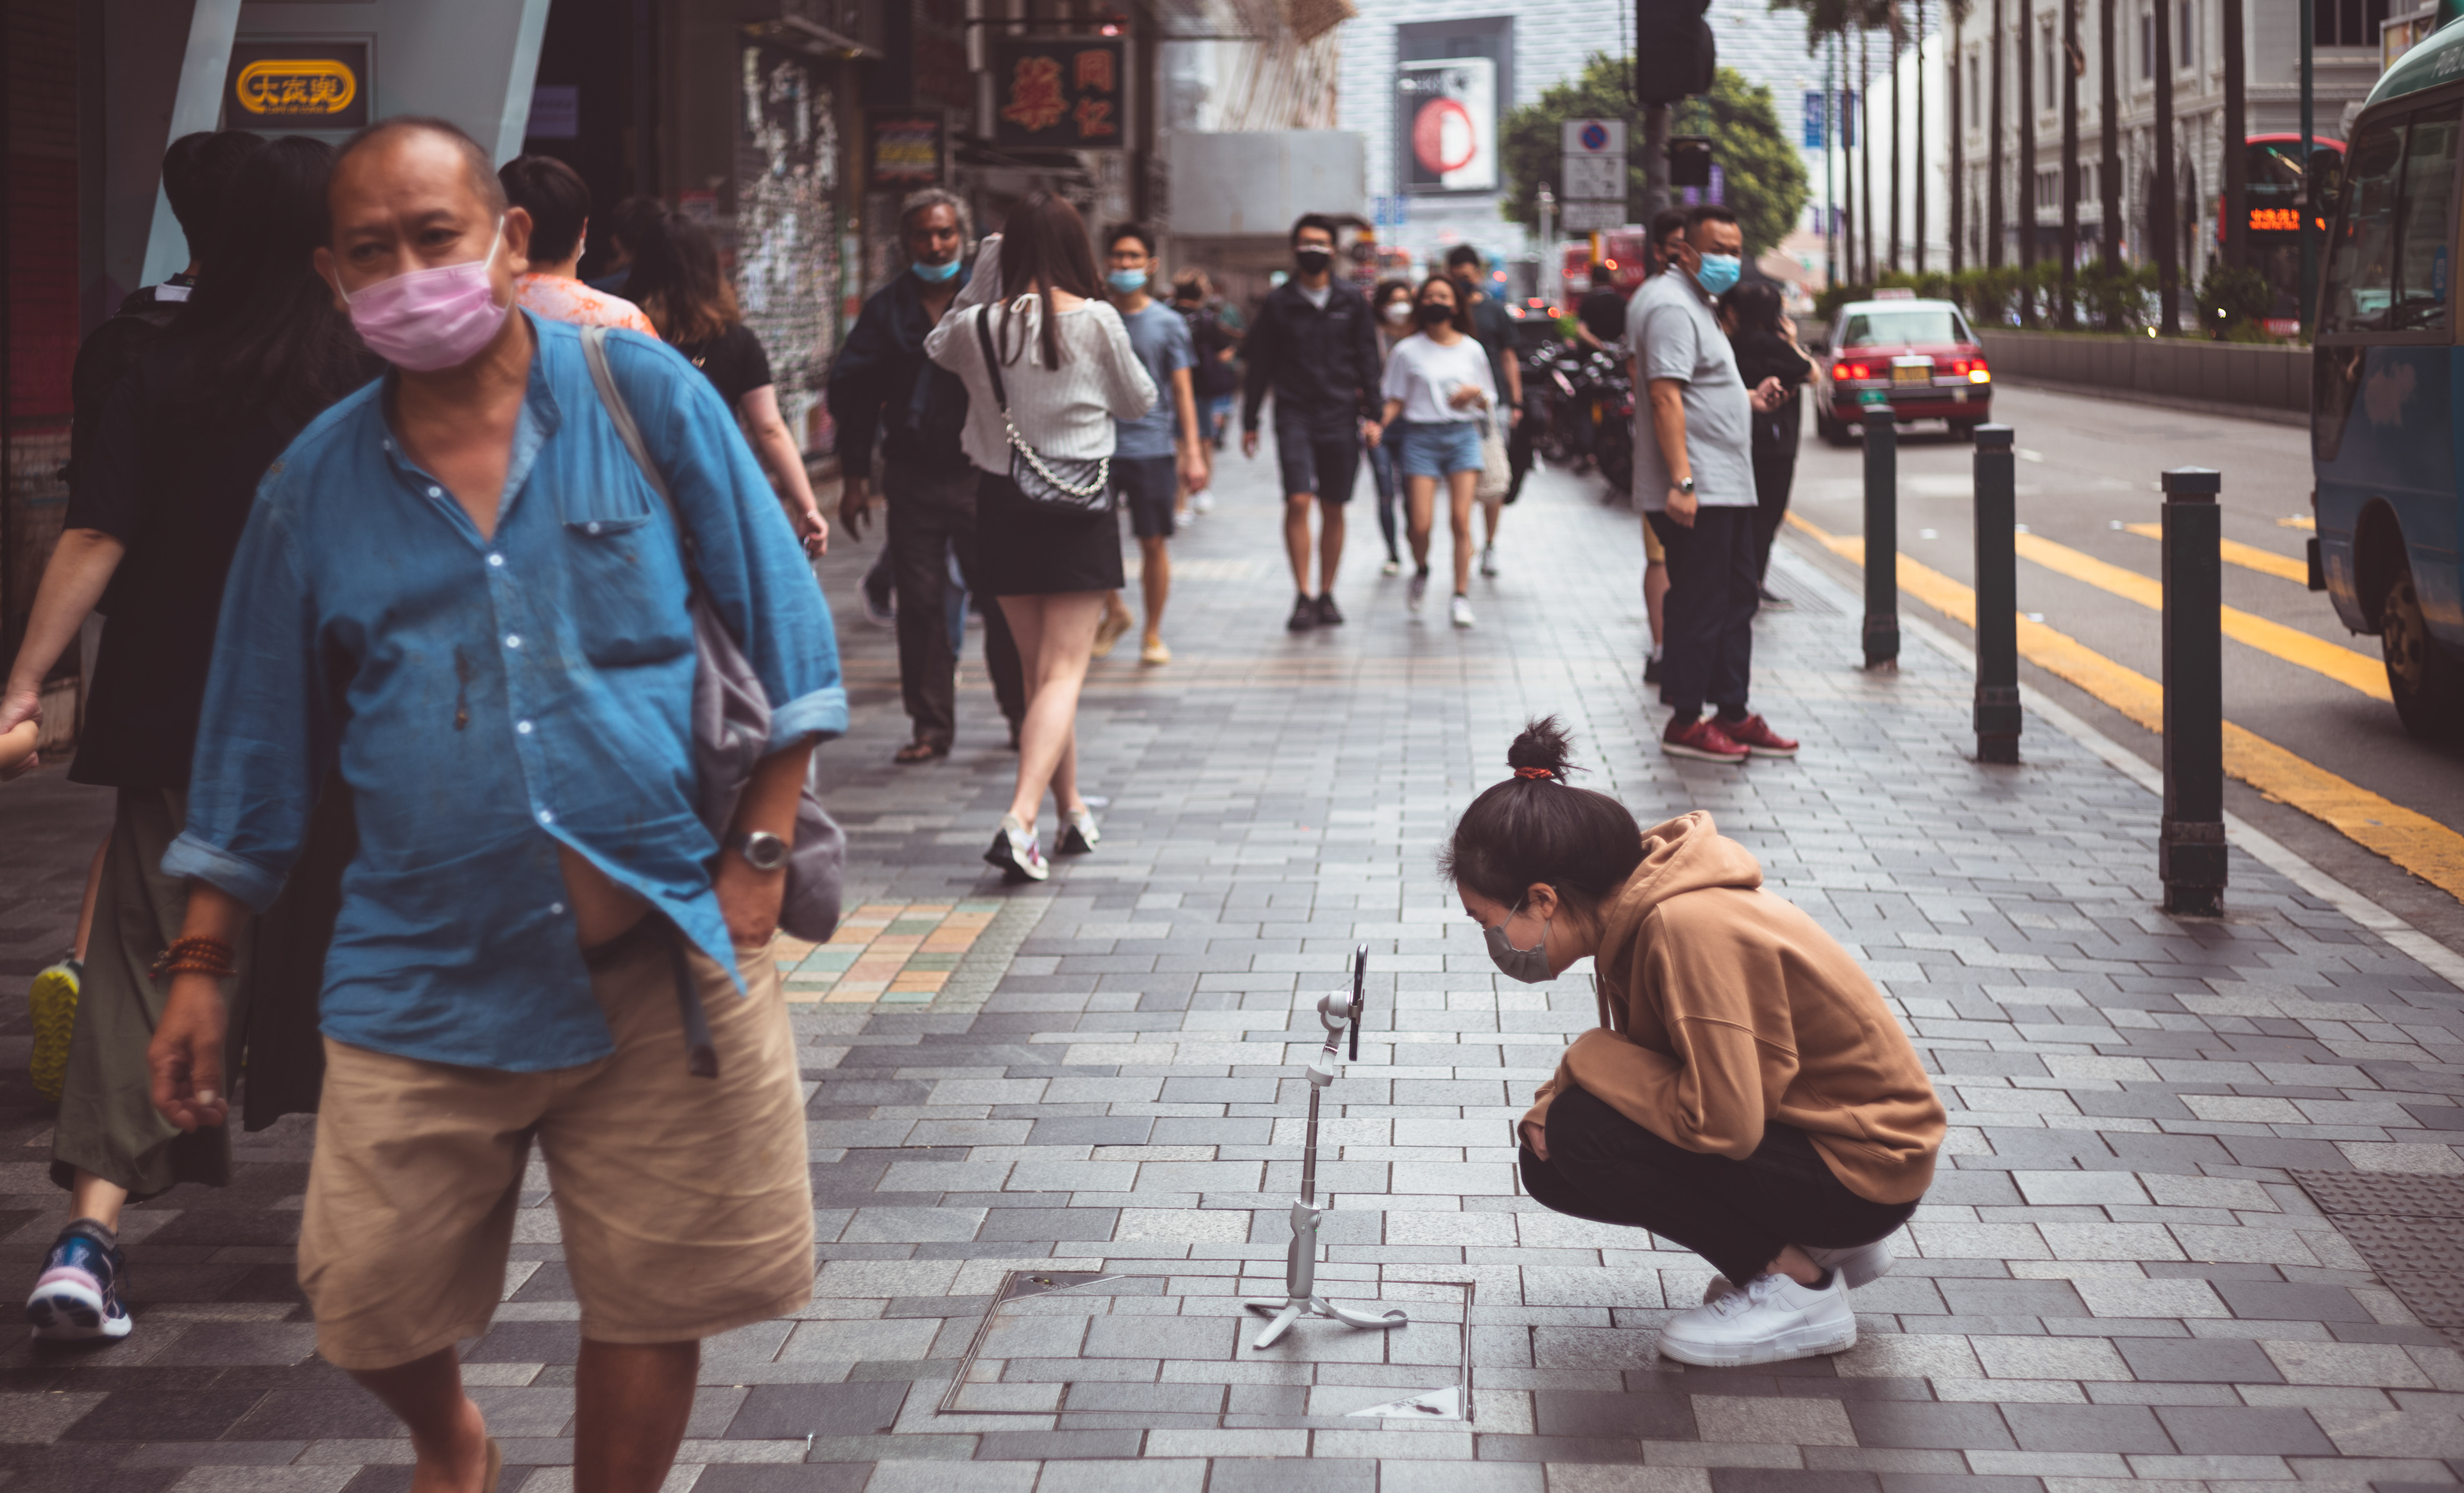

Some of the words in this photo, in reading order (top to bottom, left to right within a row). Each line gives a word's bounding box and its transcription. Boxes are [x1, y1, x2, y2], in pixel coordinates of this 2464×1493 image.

[2431, 45, 2464, 79] PUBLI
[253, 74, 338, 105] 大家樂
